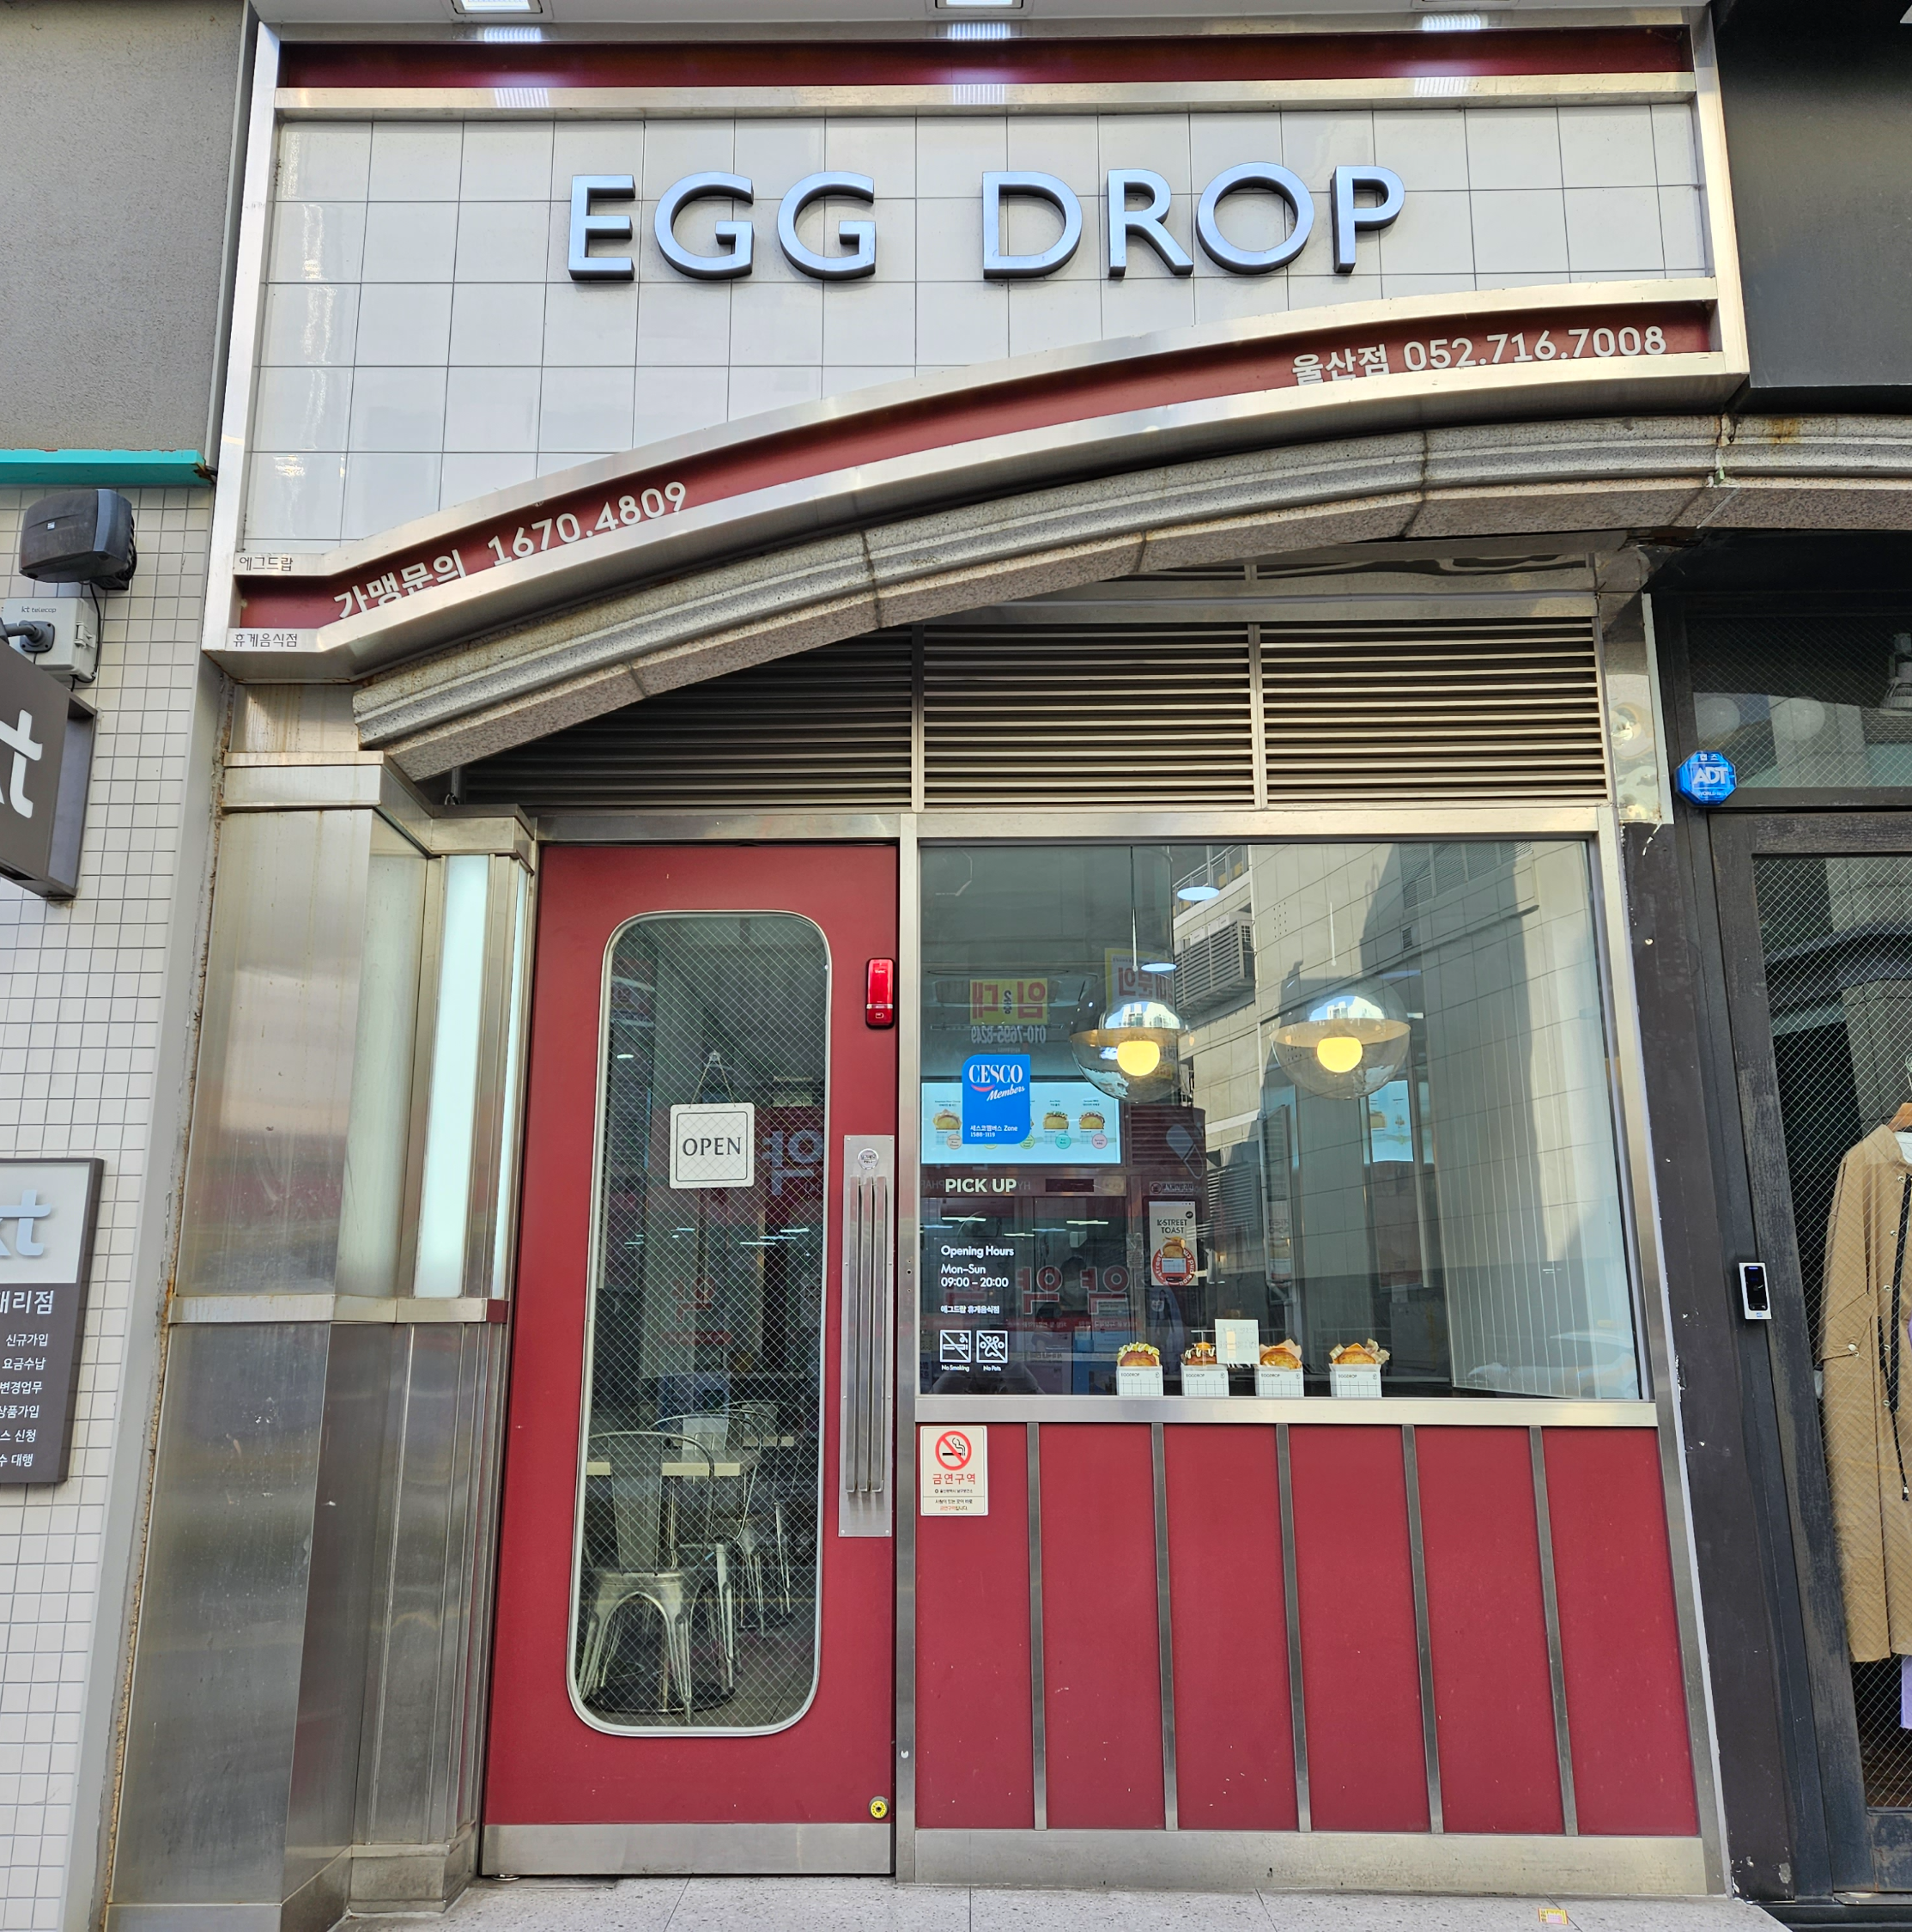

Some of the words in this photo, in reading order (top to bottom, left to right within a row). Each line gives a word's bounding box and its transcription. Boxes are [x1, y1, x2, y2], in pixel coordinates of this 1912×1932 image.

[568, 171, 877, 281] EGG
[982, 161, 1405, 280] DROP
[1291, 343, 1390, 386] 울산점
[1403, 325, 1666, 372] 052.716.7008
[333, 549, 466, 619] 가맹문의
[487, 481, 686, 567] 1670.4809
[239, 556, 294, 572] 에그드랍
[234, 633, 298, 647] 휴게음식점
[0, 709, 43, 818] t
[1693, 766, 1728, 785] ADT
[968, 1064, 1023, 1084] CESCO
[986, 1084, 1025, 1102] Members
[682, 1136, 742, 1157] OPEN
[945, 1178, 987, 1193] PICK
[992, 1178, 1017, 1193] UP
[941, 1245, 984, 1259] Opening
[986, 1245, 1015, 1256] Hours
[940, 1277, 970, 1287] 09:00
[980, 1277, 1009, 1287] 20:00
[940, 1305, 967, 1314] 에그드랍
[968, 1305, 1000, 1314] 휴게음식점
[6, 1334, 49, 1346] 신규가입
[2, 1358, 46, 1370] 요금수납
[0, 1381, 43, 1394] 변경업무
[15, 1429, 36, 1443] 신청
[11, 1453, 33, 1467] 대행
[932, 1473, 975, 1485] 금연구역
